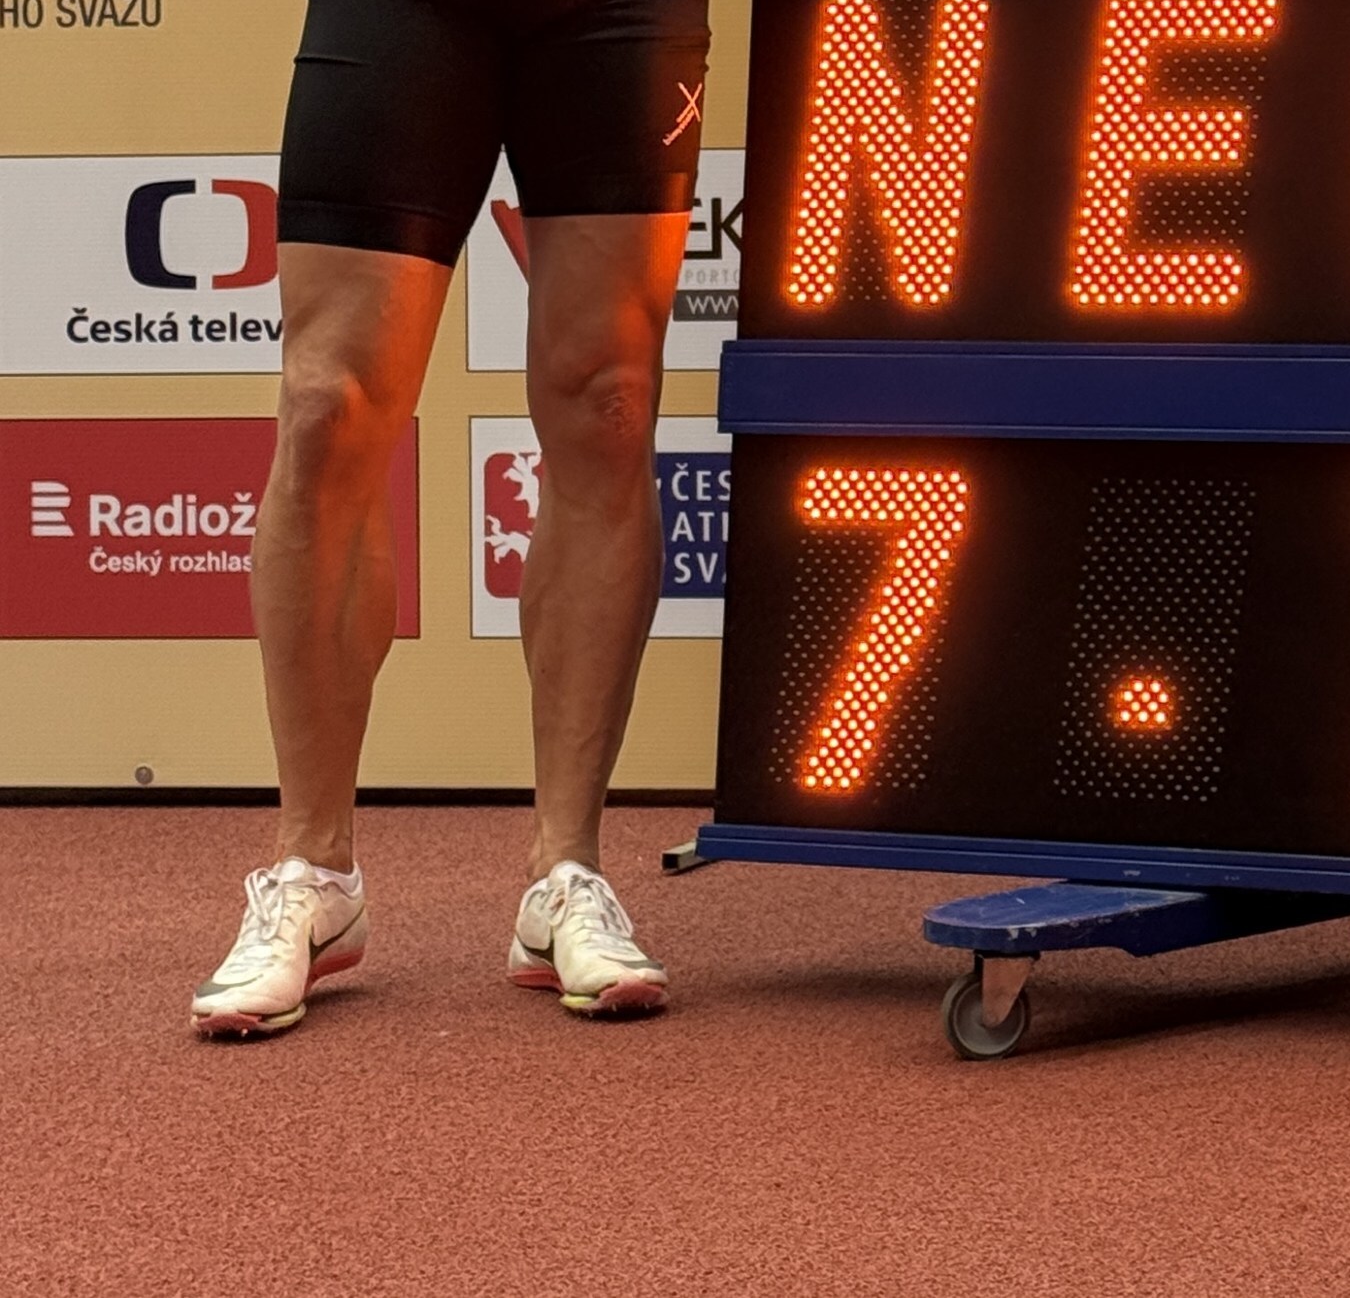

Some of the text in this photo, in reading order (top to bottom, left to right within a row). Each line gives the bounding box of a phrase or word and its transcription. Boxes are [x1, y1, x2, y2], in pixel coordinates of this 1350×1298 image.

[686, 294, 739, 315] WW
[66, 307, 283, 343] Česká telev
[89, 492, 257, 537] Radiož
[89, 546, 252, 576] Český rozhlas
[673, 552, 727, 584] SV
